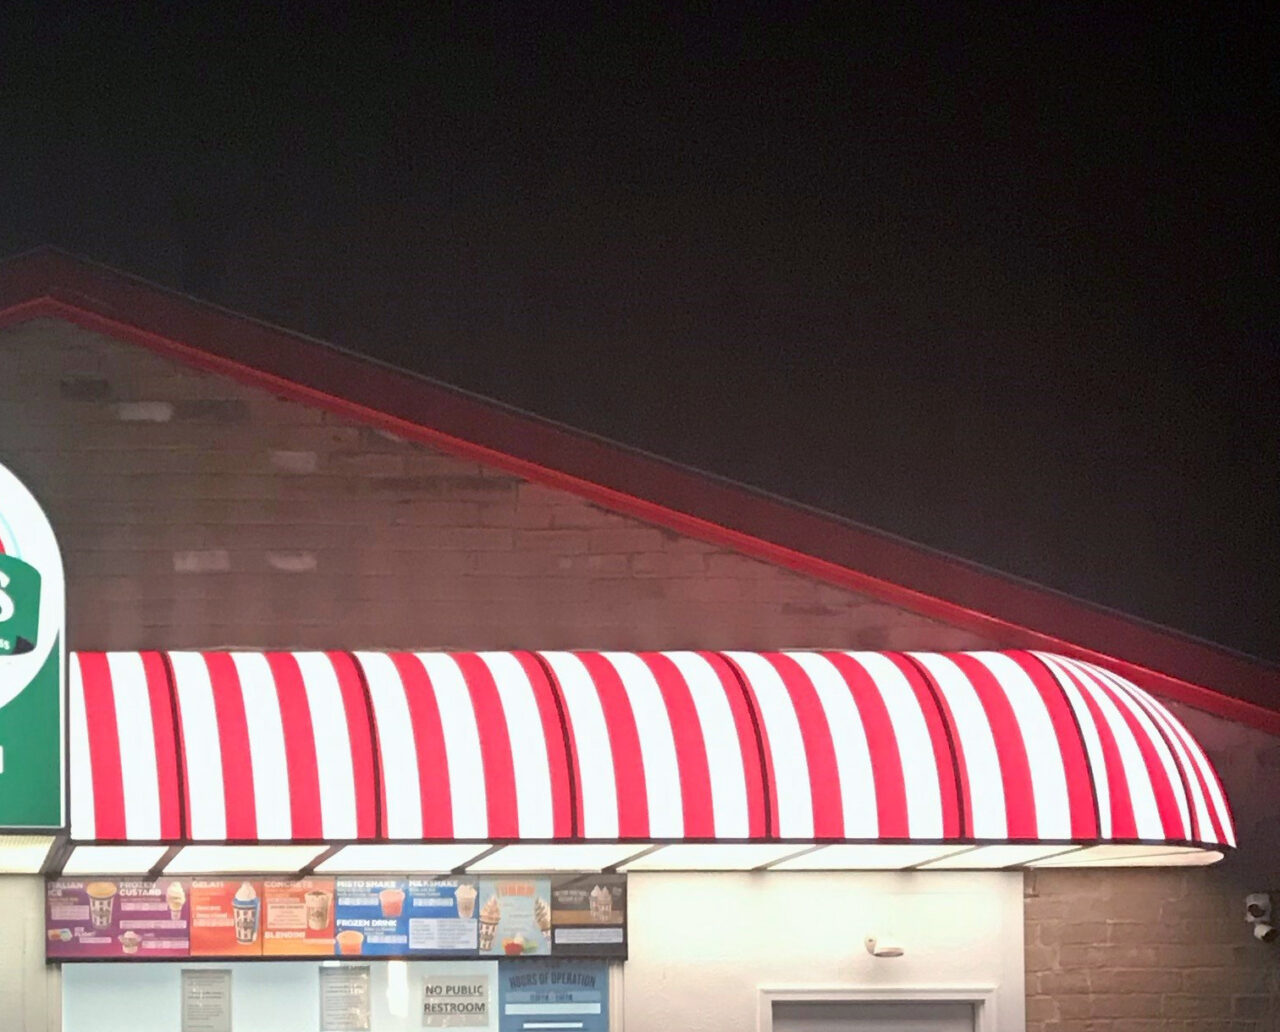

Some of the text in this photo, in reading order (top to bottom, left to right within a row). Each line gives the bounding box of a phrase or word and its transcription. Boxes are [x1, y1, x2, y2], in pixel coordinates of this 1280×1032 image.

[551, 971, 596, 988] OPERATION
[425, 984, 483, 995] NO PUBLIC
[424, 1002, 486, 1012] RESTROOM
